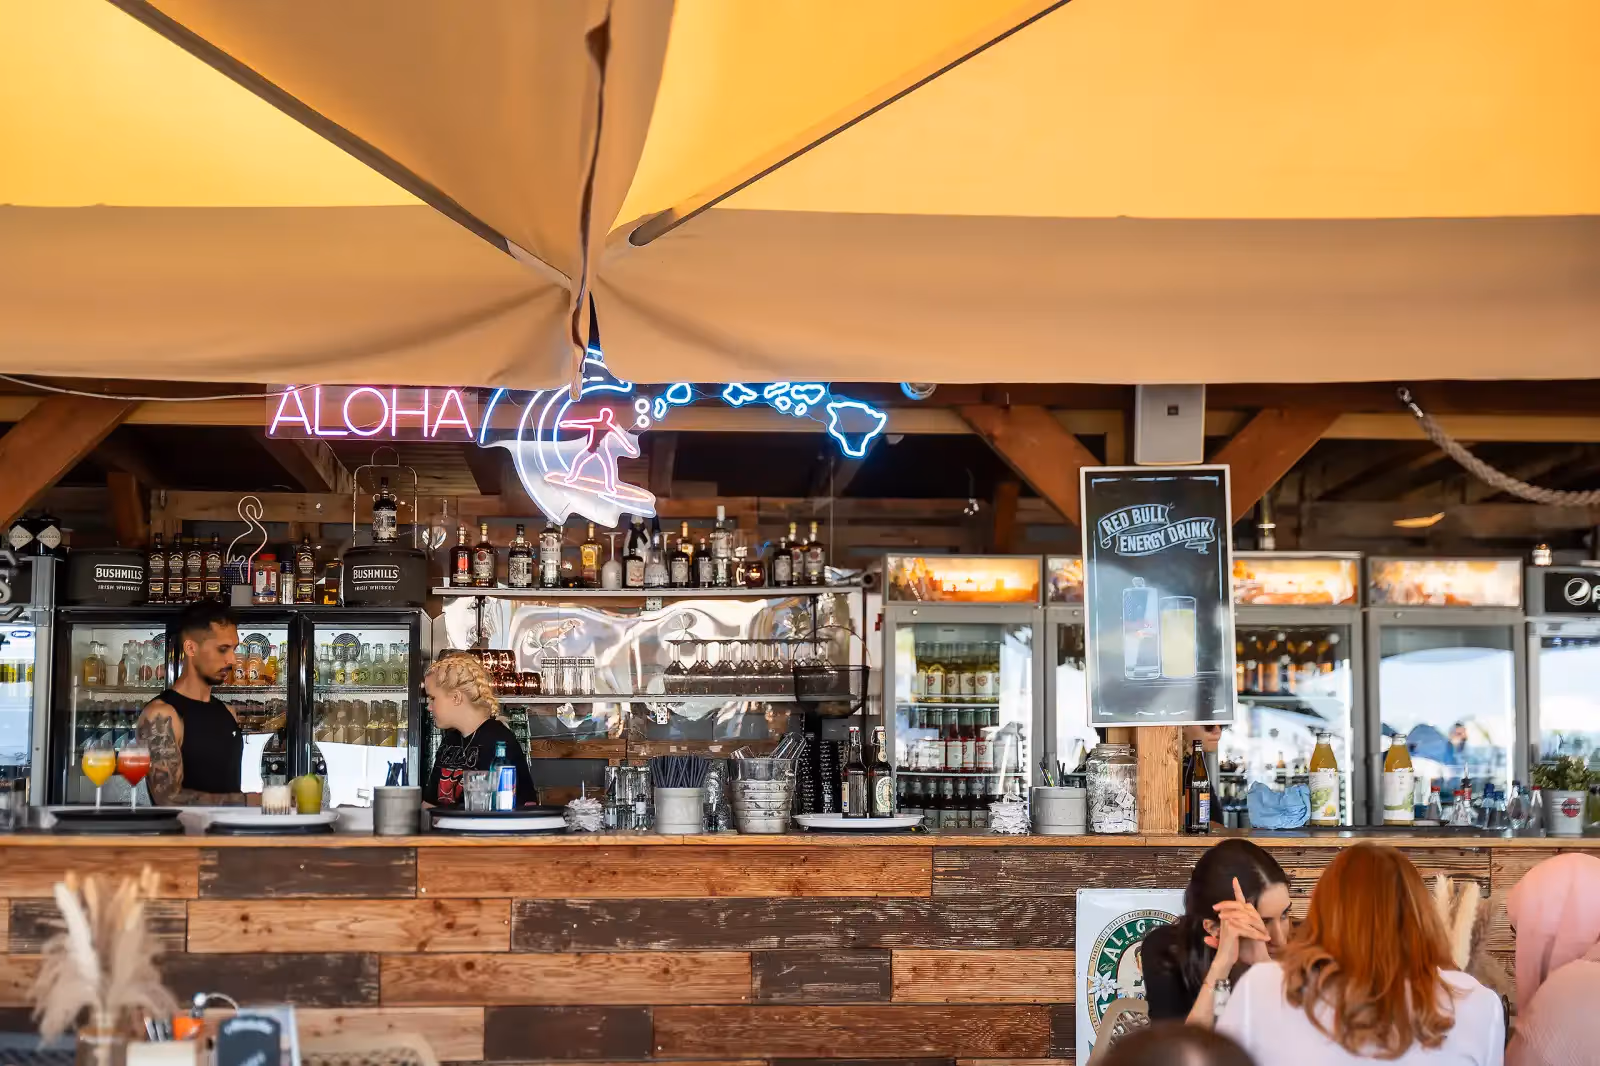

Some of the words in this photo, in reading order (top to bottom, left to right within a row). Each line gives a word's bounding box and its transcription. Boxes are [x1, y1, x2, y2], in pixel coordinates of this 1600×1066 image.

[269, 384, 474, 438] ALOHA
[1102, 513, 1130, 535] RED
[1132, 505, 1165, 524] BULL
[1119, 529, 1168, 552] ENERGY
[1168, 521, 1211, 543] DRINK
[95, 567, 143, 580] BUSHMILLS
[353, 569, 399, 579] BUSHMILLS
